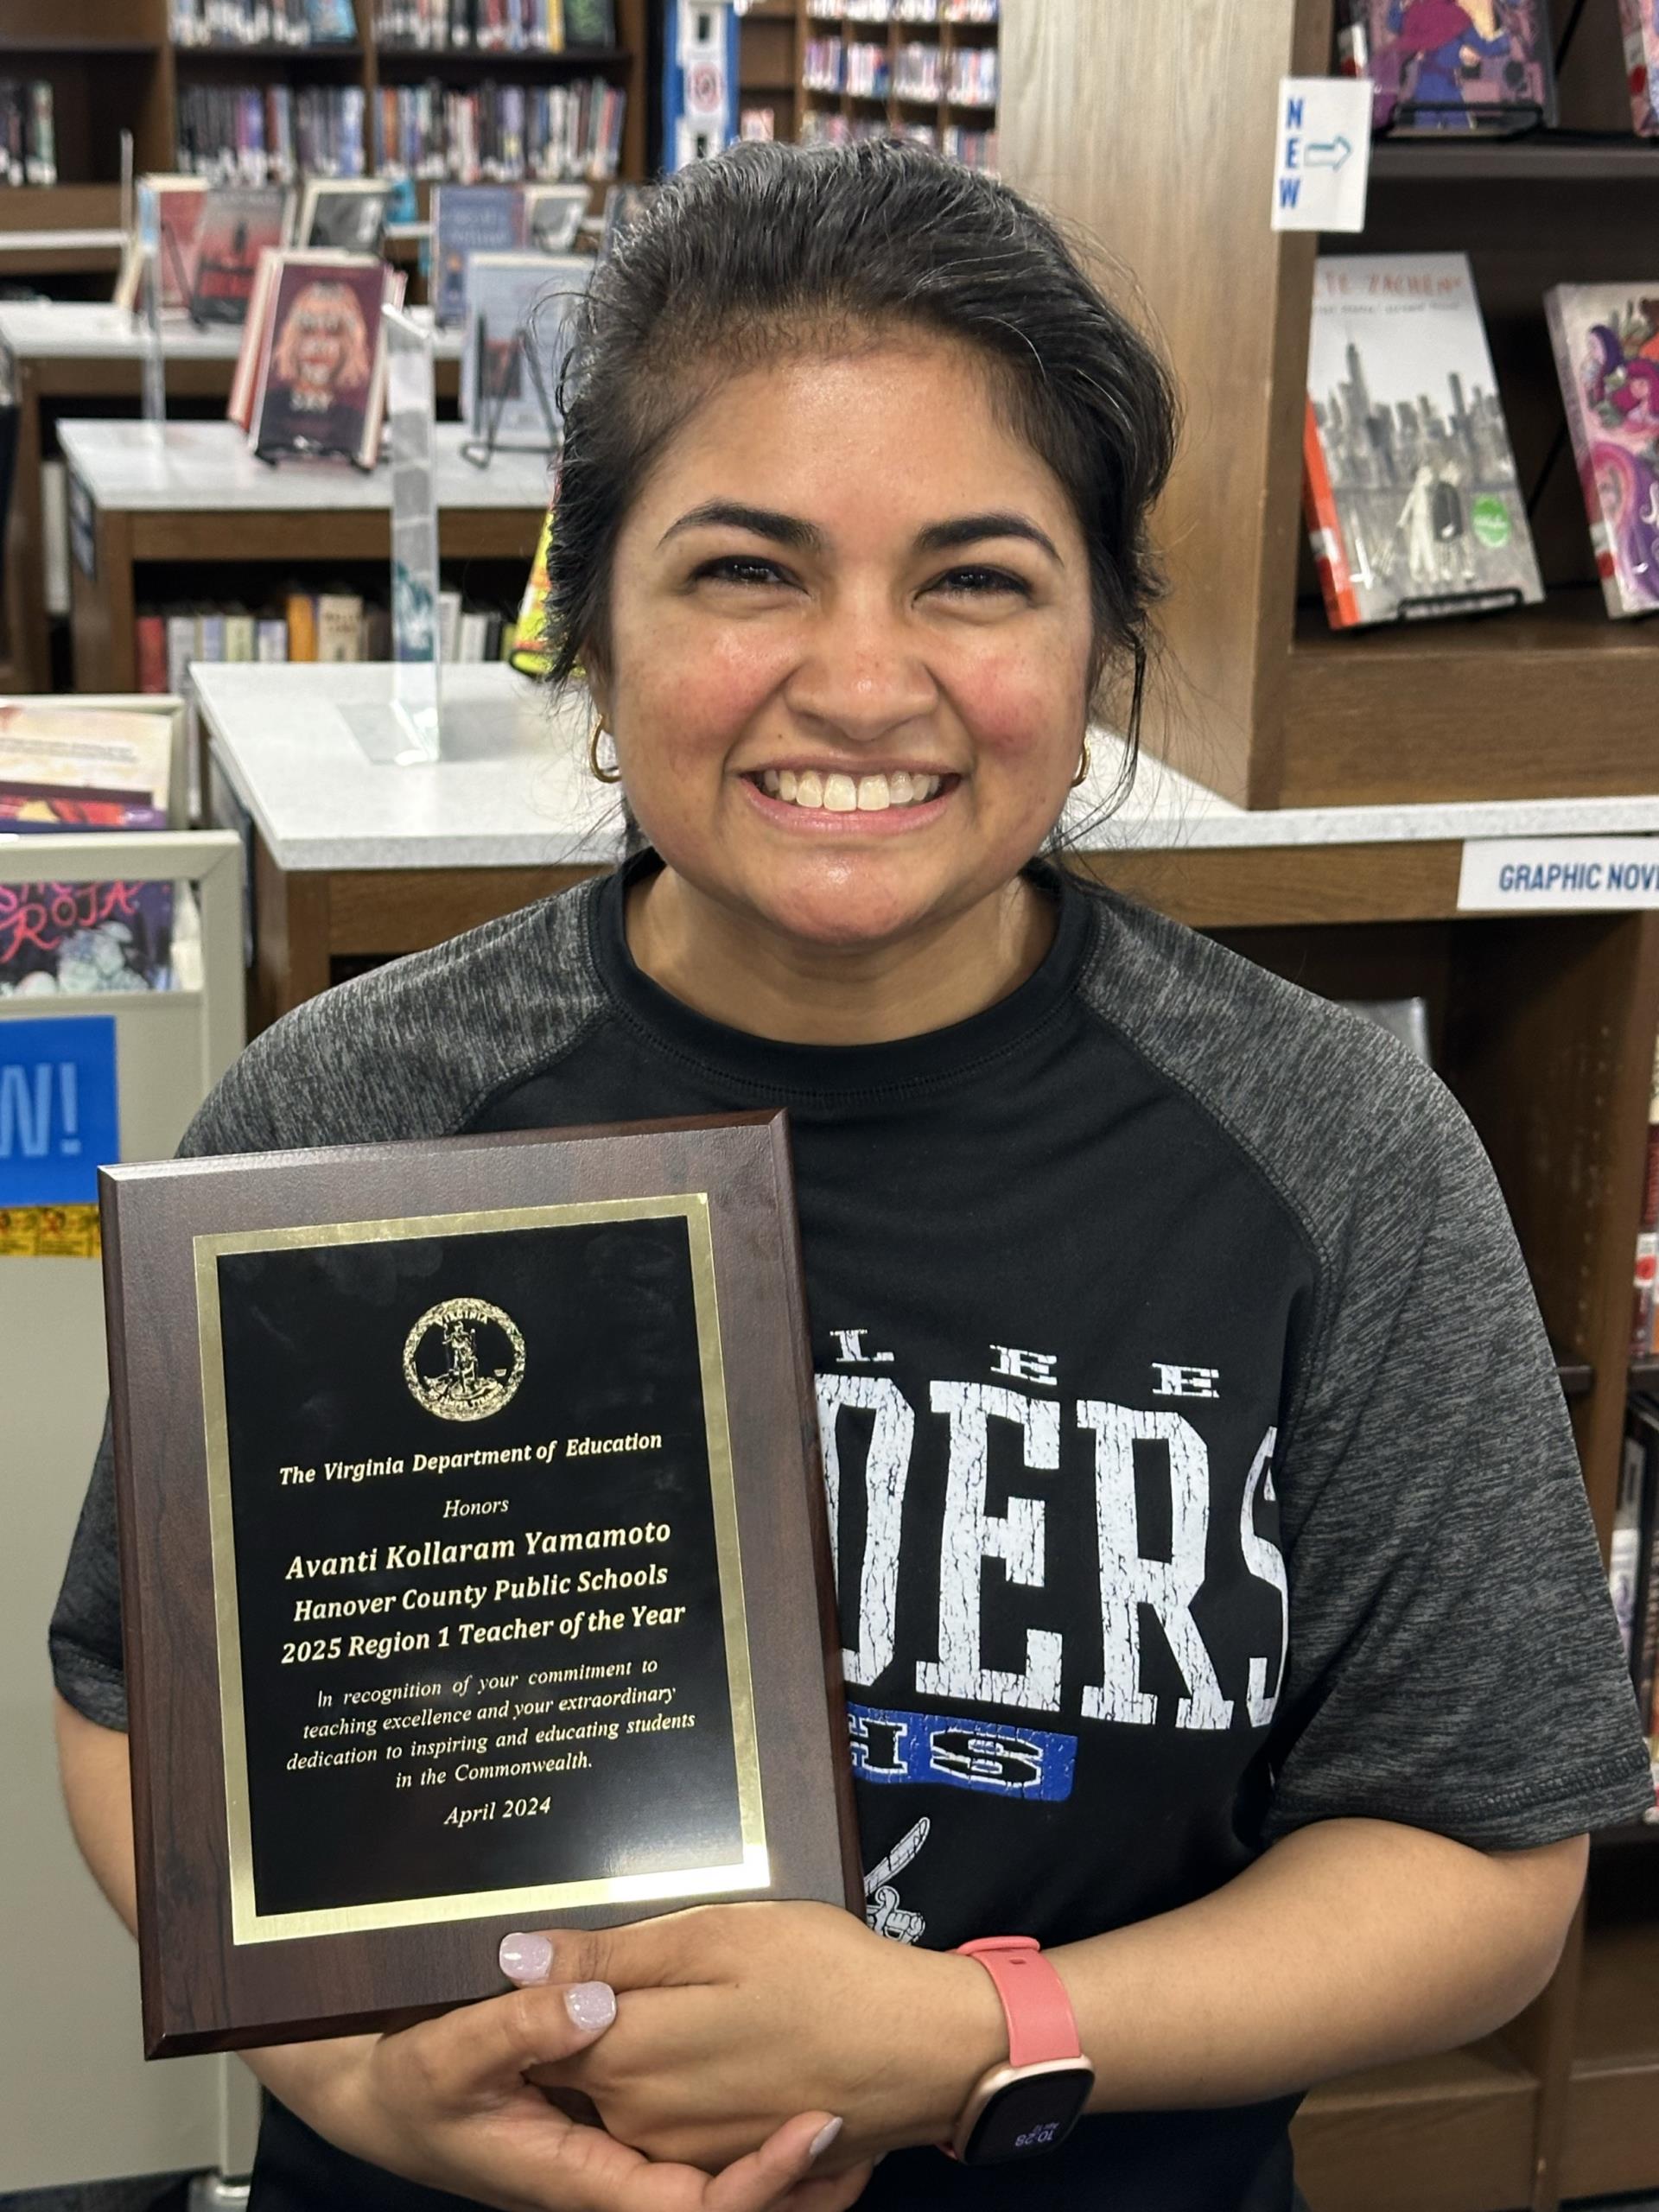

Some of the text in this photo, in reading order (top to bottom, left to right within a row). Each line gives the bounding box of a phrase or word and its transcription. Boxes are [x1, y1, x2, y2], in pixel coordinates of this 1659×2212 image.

[1279, 97, 1304, 208] NEW
[1499, 864, 1601, 892] GRAPHIC
[279, 1432, 663, 1486] The Virginia Department of Education
[442, 1499, 510, 1519] Honors
[284, 1522, 671, 1580] Avanti Kollaram Yamamoto
[293, 1563, 669, 1622] Hanover County Public Schools
[280, 1605, 686, 1665] 2025 Region 1 Teacher of the Year
[317, 1660, 658, 1708] In recognition of your commitment to
[303, 1687, 677, 1739] teaching excellence and your extraordinary
[286, 1713, 696, 1771] dedication to inspiring and educating students
[395, 1751, 593, 1789] in the Commonwealth.
[442, 1796, 551, 1828] April 2024
